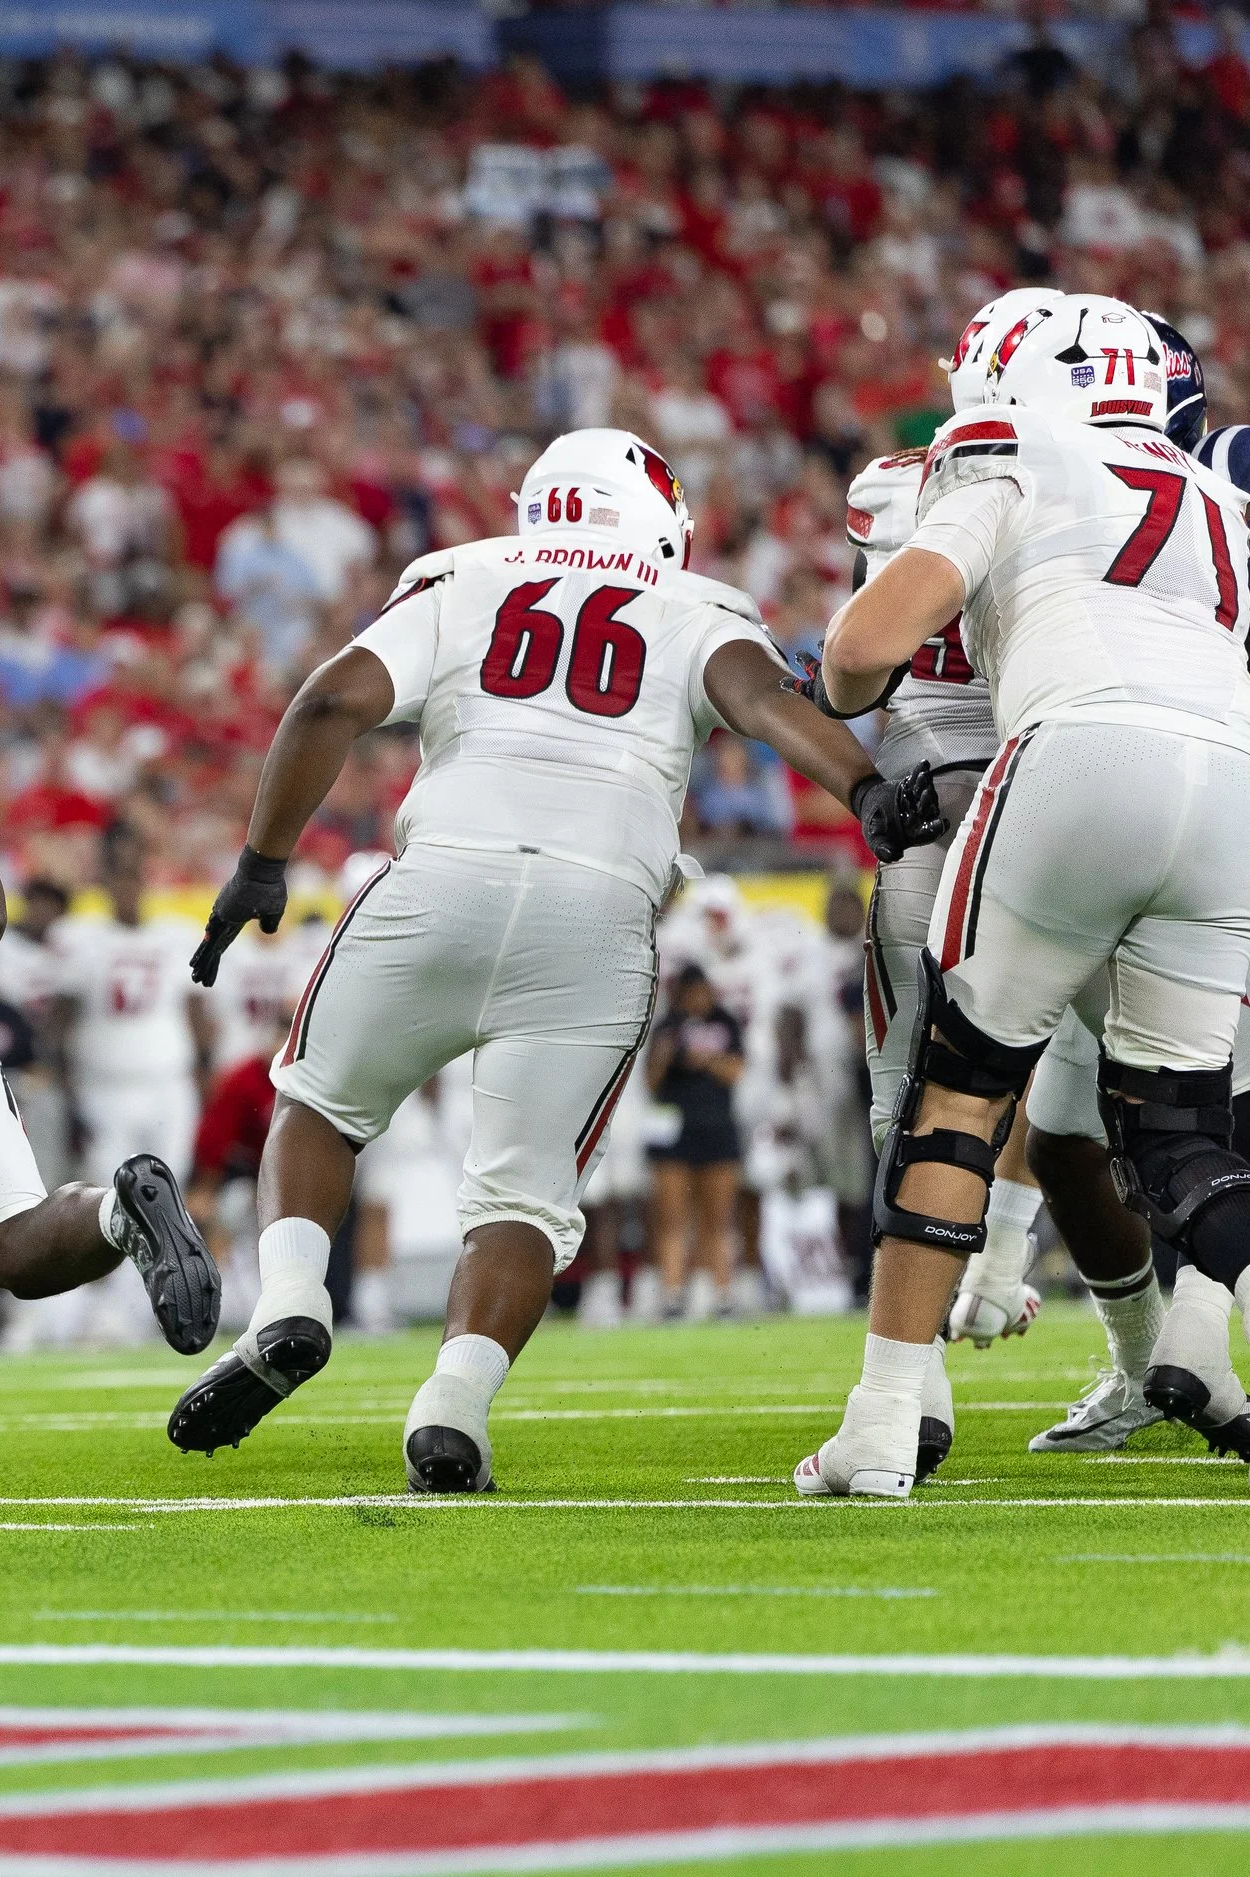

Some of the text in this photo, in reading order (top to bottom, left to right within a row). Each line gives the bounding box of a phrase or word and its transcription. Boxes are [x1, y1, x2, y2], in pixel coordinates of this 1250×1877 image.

[1072, 367, 1093, 375] USA
[1100, 348, 1136, 386] 71
[1161, 341, 1192, 381] iss
[1072, 376, 1095, 385] 250
[1090, 399, 1154, 417] LOUISVILLE
[547, 487, 583, 523] 66
[1102, 462, 1239, 632] 71
[535, 549, 633, 572] BROWN
[637, 560, 659, 586] III
[480, 577, 647, 718] 66
[924, 1225, 977, 1242] DONJOY
